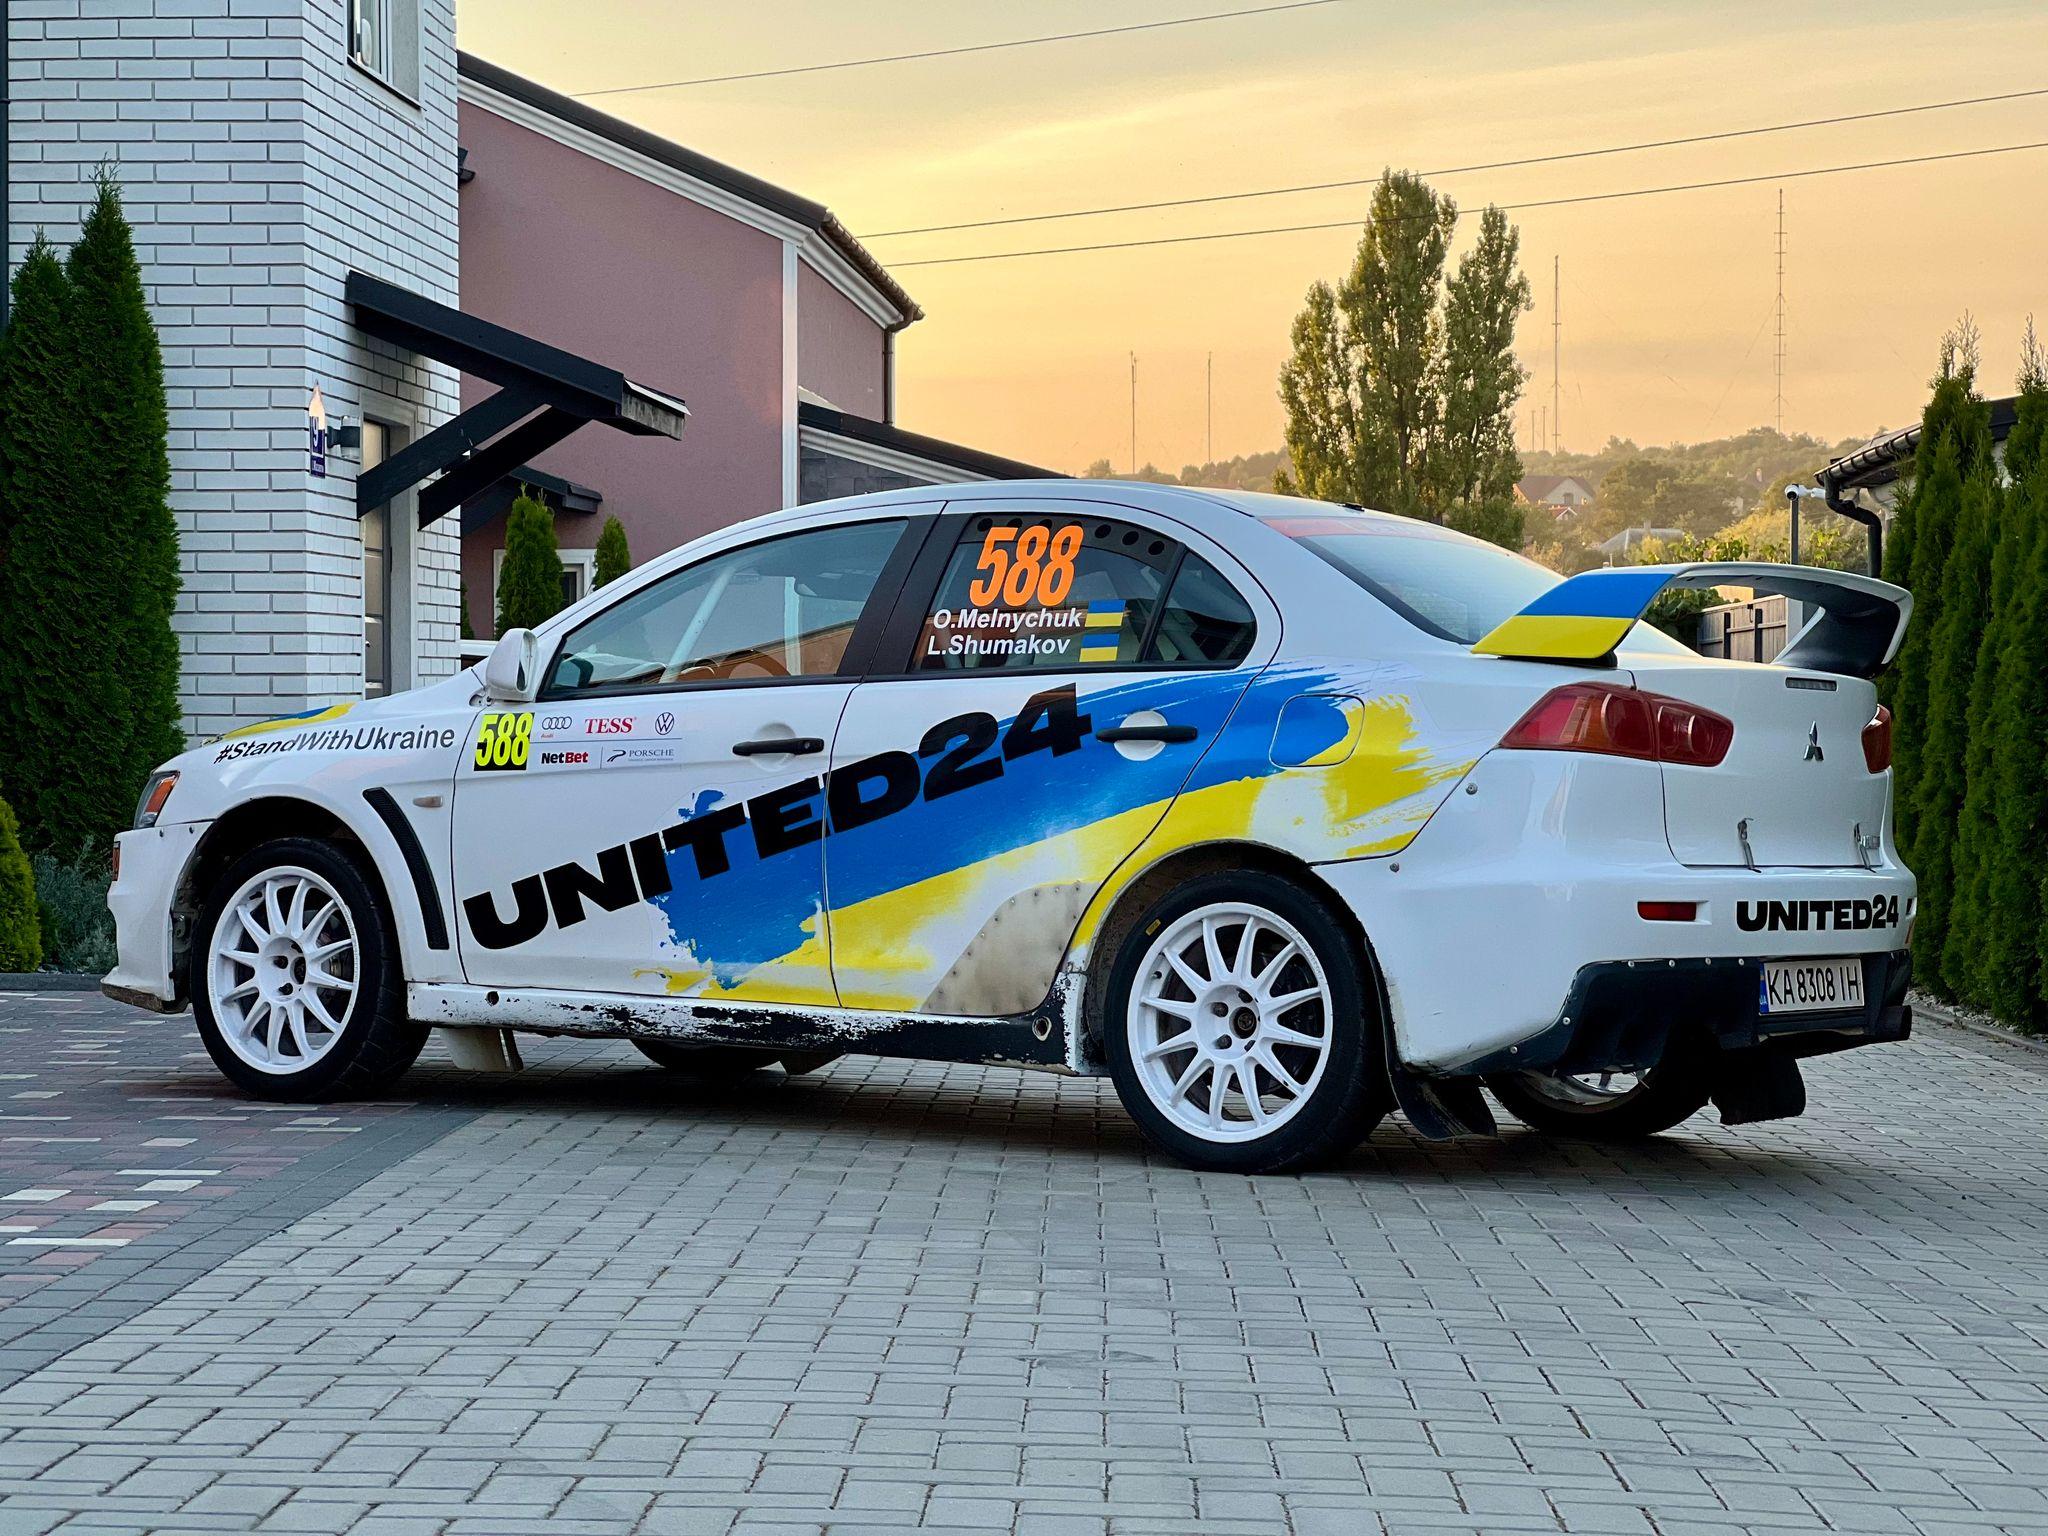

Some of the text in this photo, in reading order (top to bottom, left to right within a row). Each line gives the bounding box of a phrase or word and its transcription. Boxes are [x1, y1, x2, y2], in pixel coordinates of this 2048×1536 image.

[969, 525, 1084, 607] 588
[933, 607, 1081, 633] O.Melnychuk
[928, 634, 1070, 656] L.Shumakov
[474, 712, 533, 766] 588
[585, 717, 633, 734] TESS
[213, 724, 455, 765] #StandWithUkraine
[541, 752, 588, 764] NetBet
[629, 748, 674, 758] PORSCHE
[463, 682, 1093, 950] UNITED24
[1736, 894, 1899, 931] UNITED24
[1767, 966, 1860, 1005] KA 8308 IH
